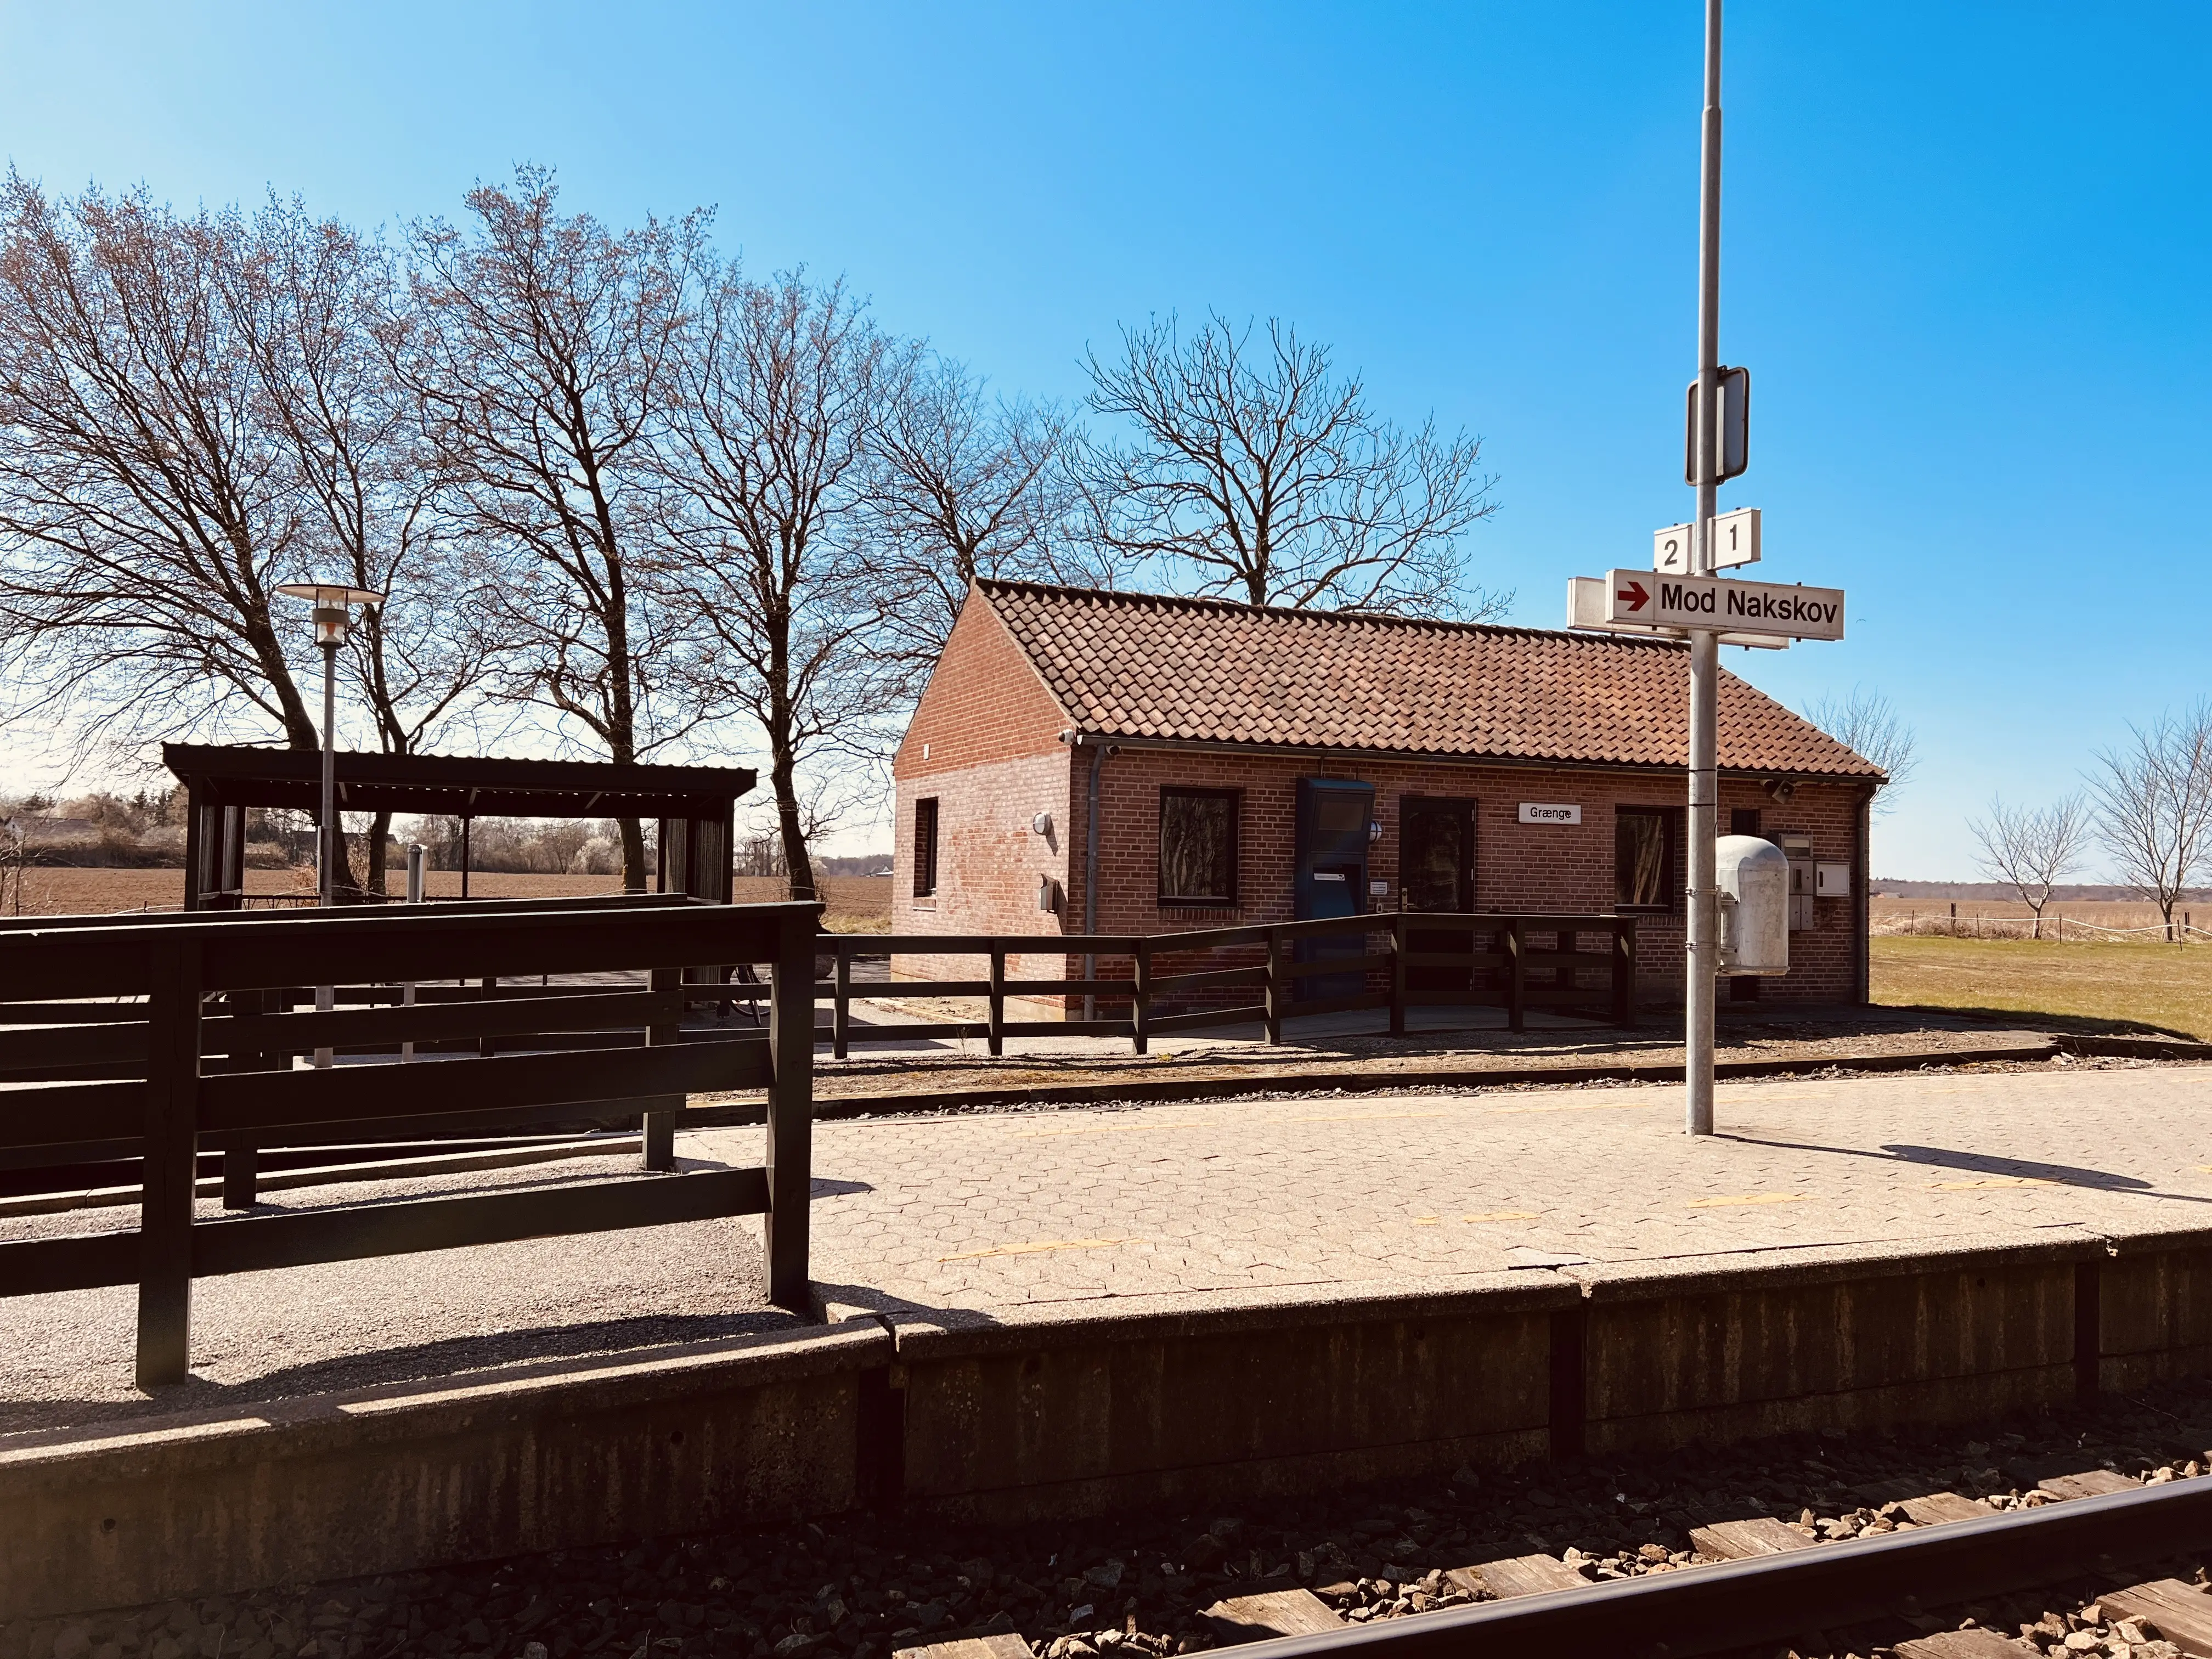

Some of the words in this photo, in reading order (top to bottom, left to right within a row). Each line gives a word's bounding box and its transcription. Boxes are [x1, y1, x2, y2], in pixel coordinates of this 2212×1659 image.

[1729, 524, 1737, 551] 1
[1664, 539, 1678, 566] 2
[1661, 583, 1716, 614] Mod
[1727, 589, 1838, 623] Nakskov
[1530, 806, 1571, 821] Grænge
